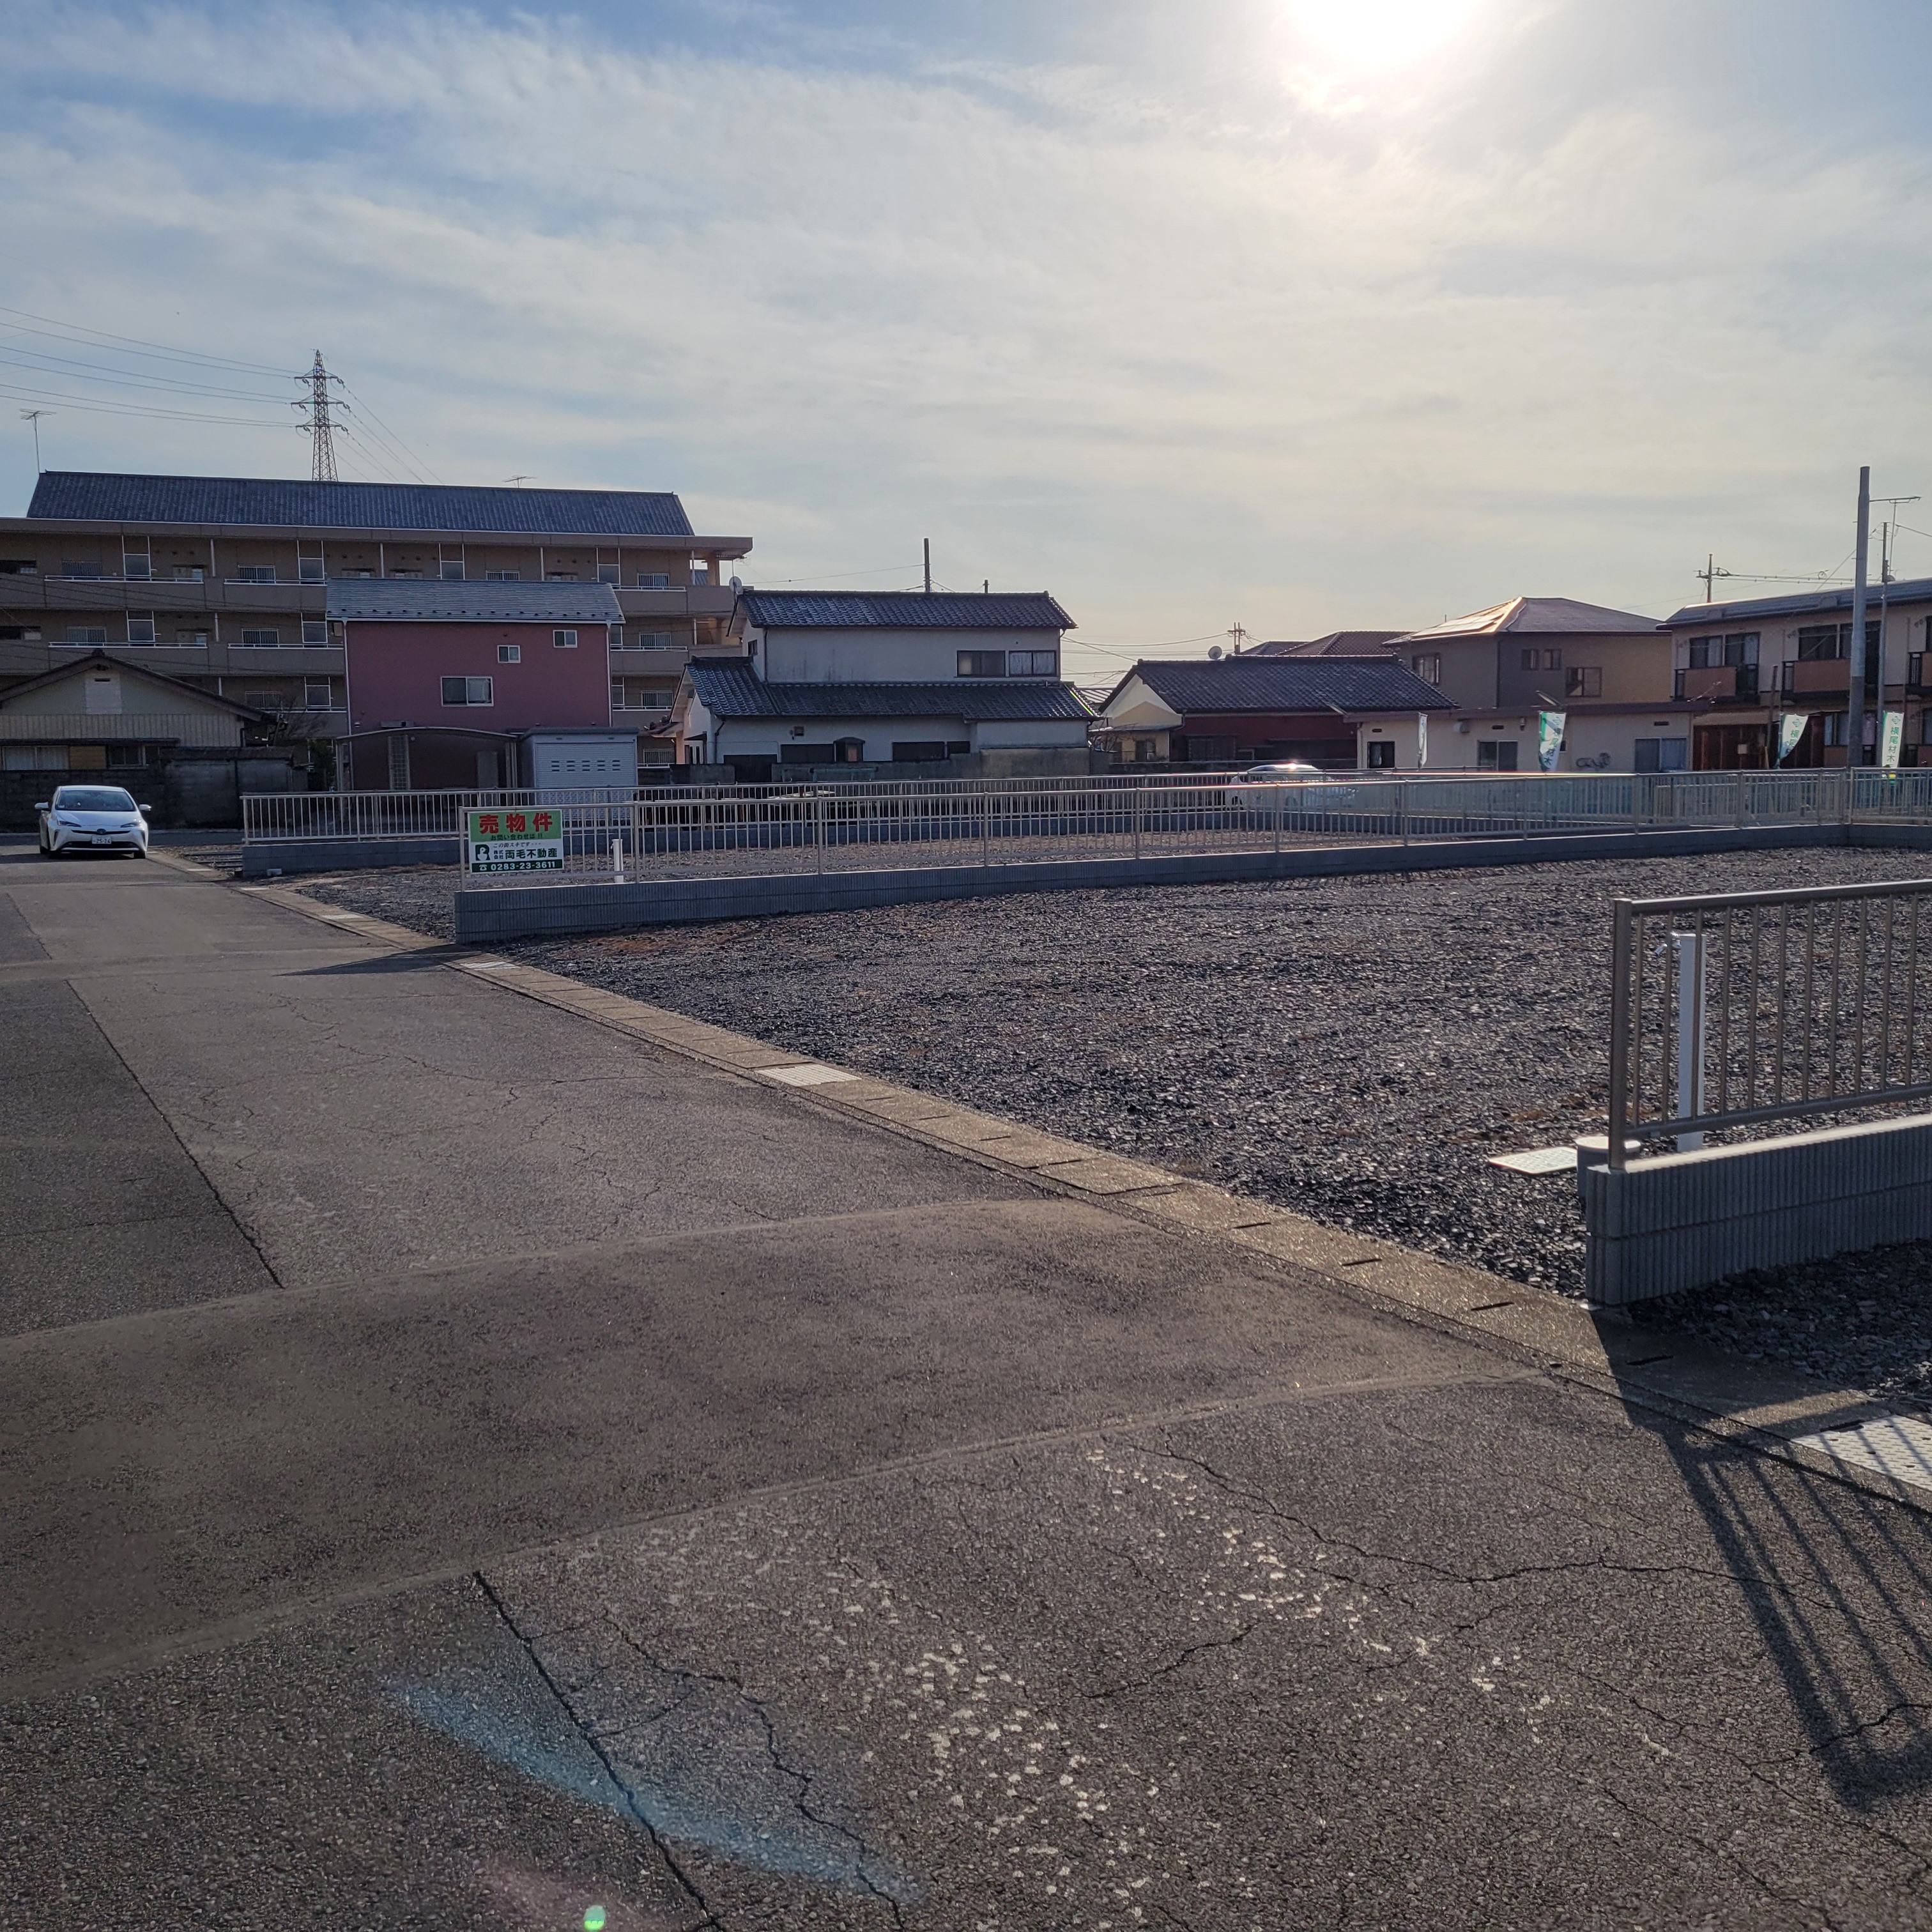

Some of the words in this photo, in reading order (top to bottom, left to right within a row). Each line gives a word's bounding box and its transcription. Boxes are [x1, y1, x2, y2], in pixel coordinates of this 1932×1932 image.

[1886, 726, 1899, 765] 横尾材木
[479, 813, 552, 834] 売物件
[491, 861, 555, 871] 0283-23-3611
